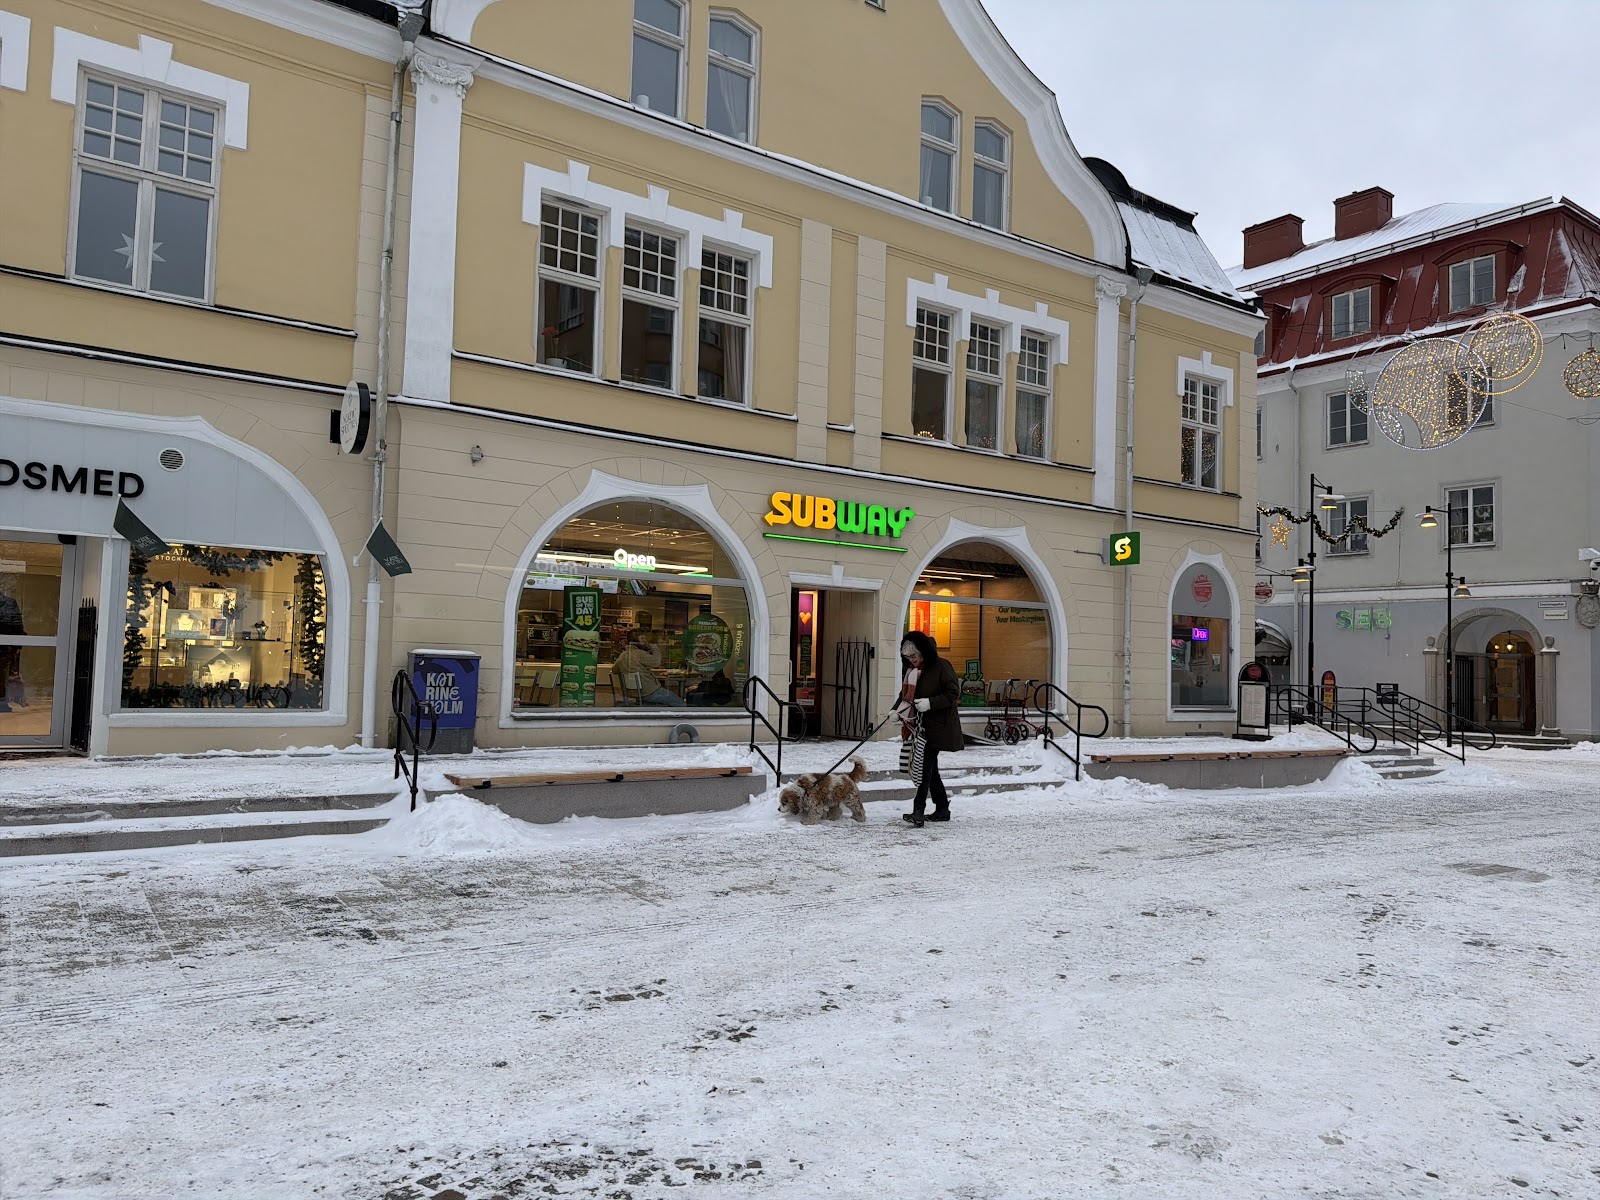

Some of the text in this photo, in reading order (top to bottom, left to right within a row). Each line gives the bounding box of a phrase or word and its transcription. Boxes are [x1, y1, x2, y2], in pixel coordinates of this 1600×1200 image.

[764, 492, 916, 538] SUBWAY
[614, 548, 656, 569] Open
[575, 595, 594, 603] SUB
[575, 607, 594, 615] DAY
[575, 615, 593, 626] 45
[1336, 608, 1392, 629] SEB
[425, 687, 461, 700] RINE
